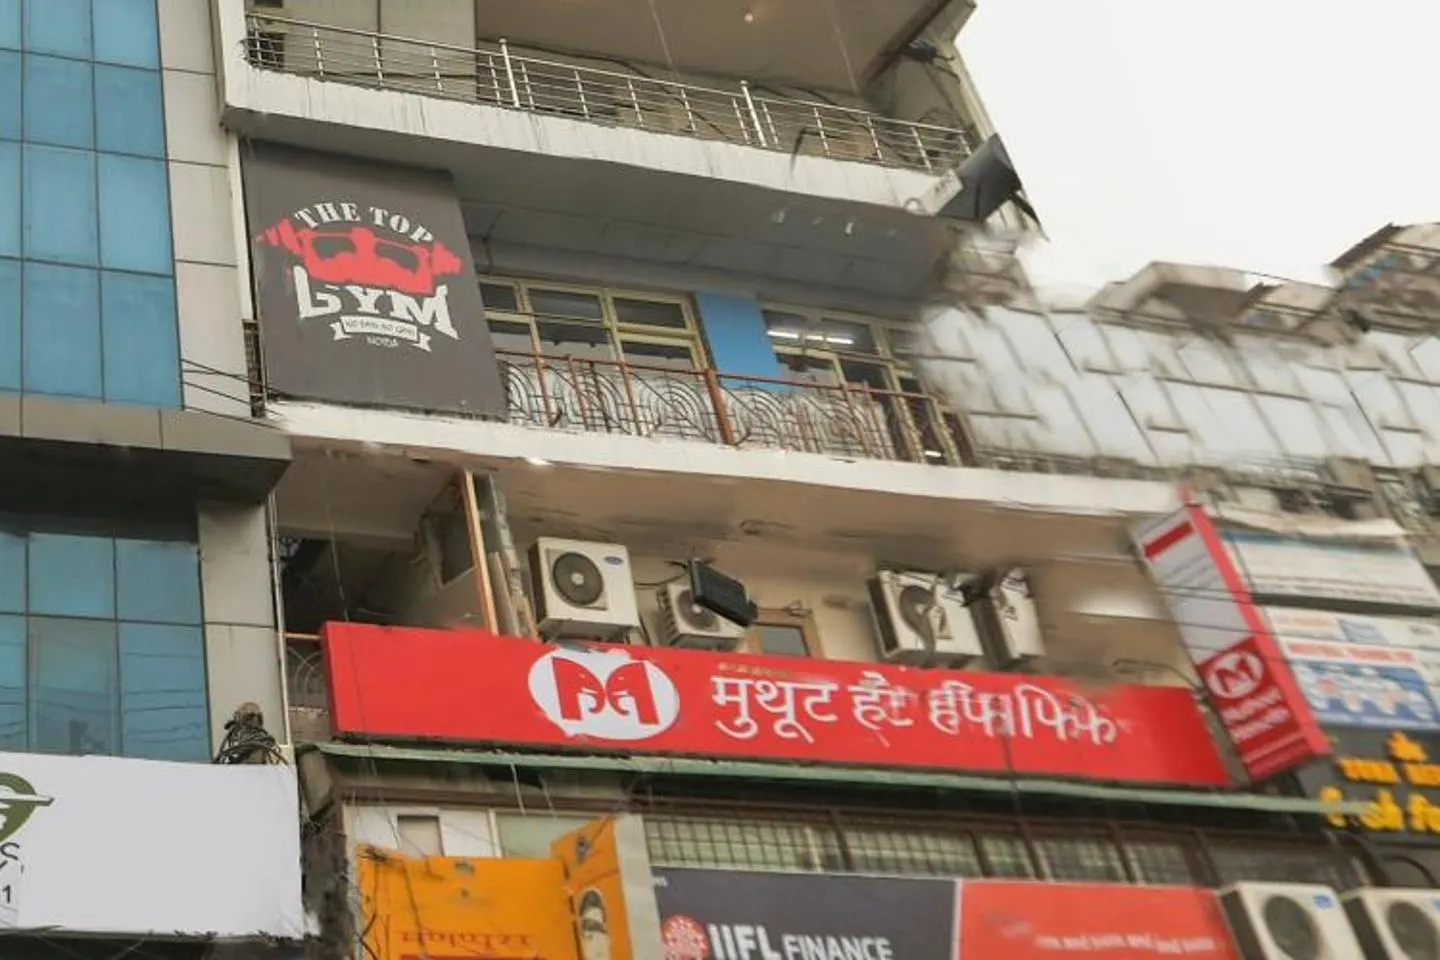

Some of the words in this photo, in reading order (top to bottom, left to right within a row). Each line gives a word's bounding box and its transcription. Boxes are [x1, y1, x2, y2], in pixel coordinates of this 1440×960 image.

[294, 202, 361, 229] THE
[369, 206, 434, 243] TOP
[293, 265, 459, 340] GYM
[711, 675, 838, 744] मुथूट
[706, 923, 782, 960] IIFL
[781, 934, 893, 960] FINANCE
